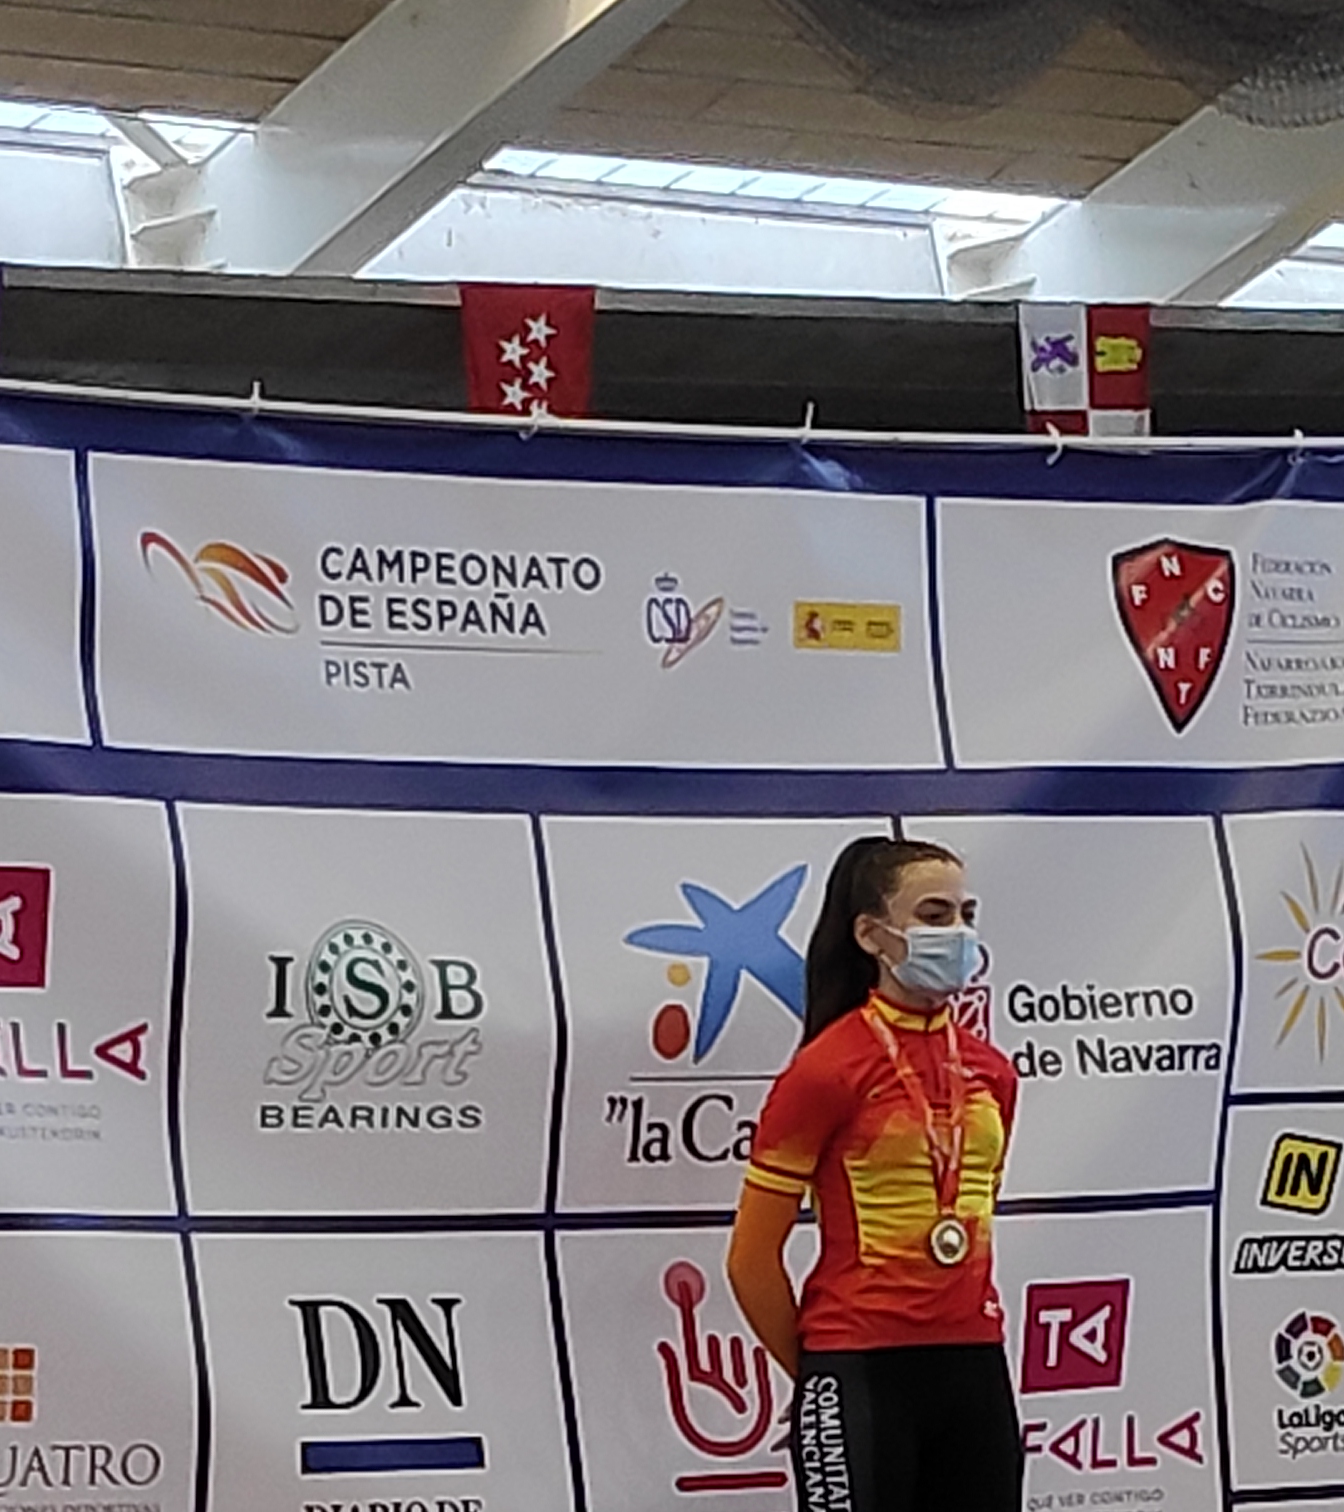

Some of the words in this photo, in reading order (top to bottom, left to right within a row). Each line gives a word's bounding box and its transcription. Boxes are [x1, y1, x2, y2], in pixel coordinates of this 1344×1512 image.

[320, 546, 602, 591] CAMPEONATO
[319, 594, 371, 631] DE
[386, 592, 547, 638] ESPAÑA
[325, 660, 412, 691] PISTA
[1008, 982, 1193, 1022] Gobierno
[263, 1023, 483, 1103] Sport
[1012, 1041, 1061, 1079] de
[1078, 1038, 1222, 1075] Navarra
[259, 1104, 484, 1130] BEARINGS
[289, 1296, 464, 1411] DN
